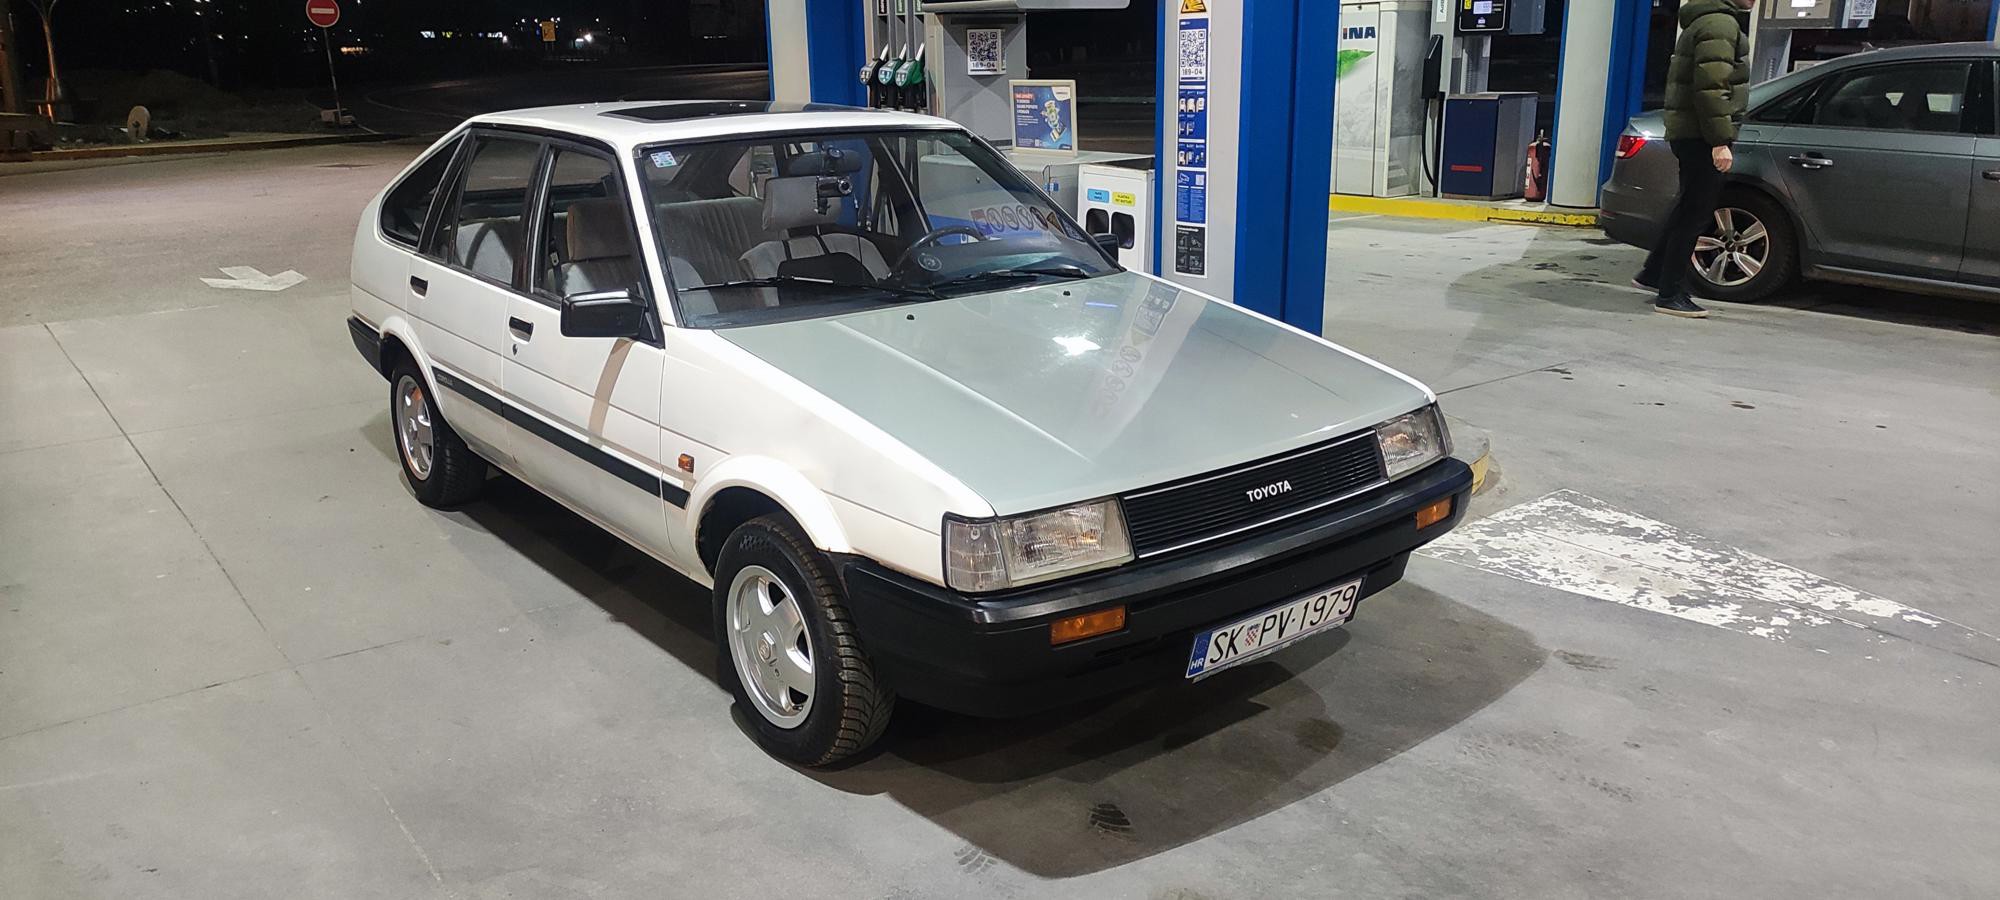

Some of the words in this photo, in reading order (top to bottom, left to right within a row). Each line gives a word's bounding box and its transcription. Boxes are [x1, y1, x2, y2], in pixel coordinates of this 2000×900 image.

[1343, 27, 1376, 39] INA
[1246, 480, 1292, 502] TOYOTA
[1210, 625, 1245, 663] SK
[1190, 657, 1204, 670] HR
